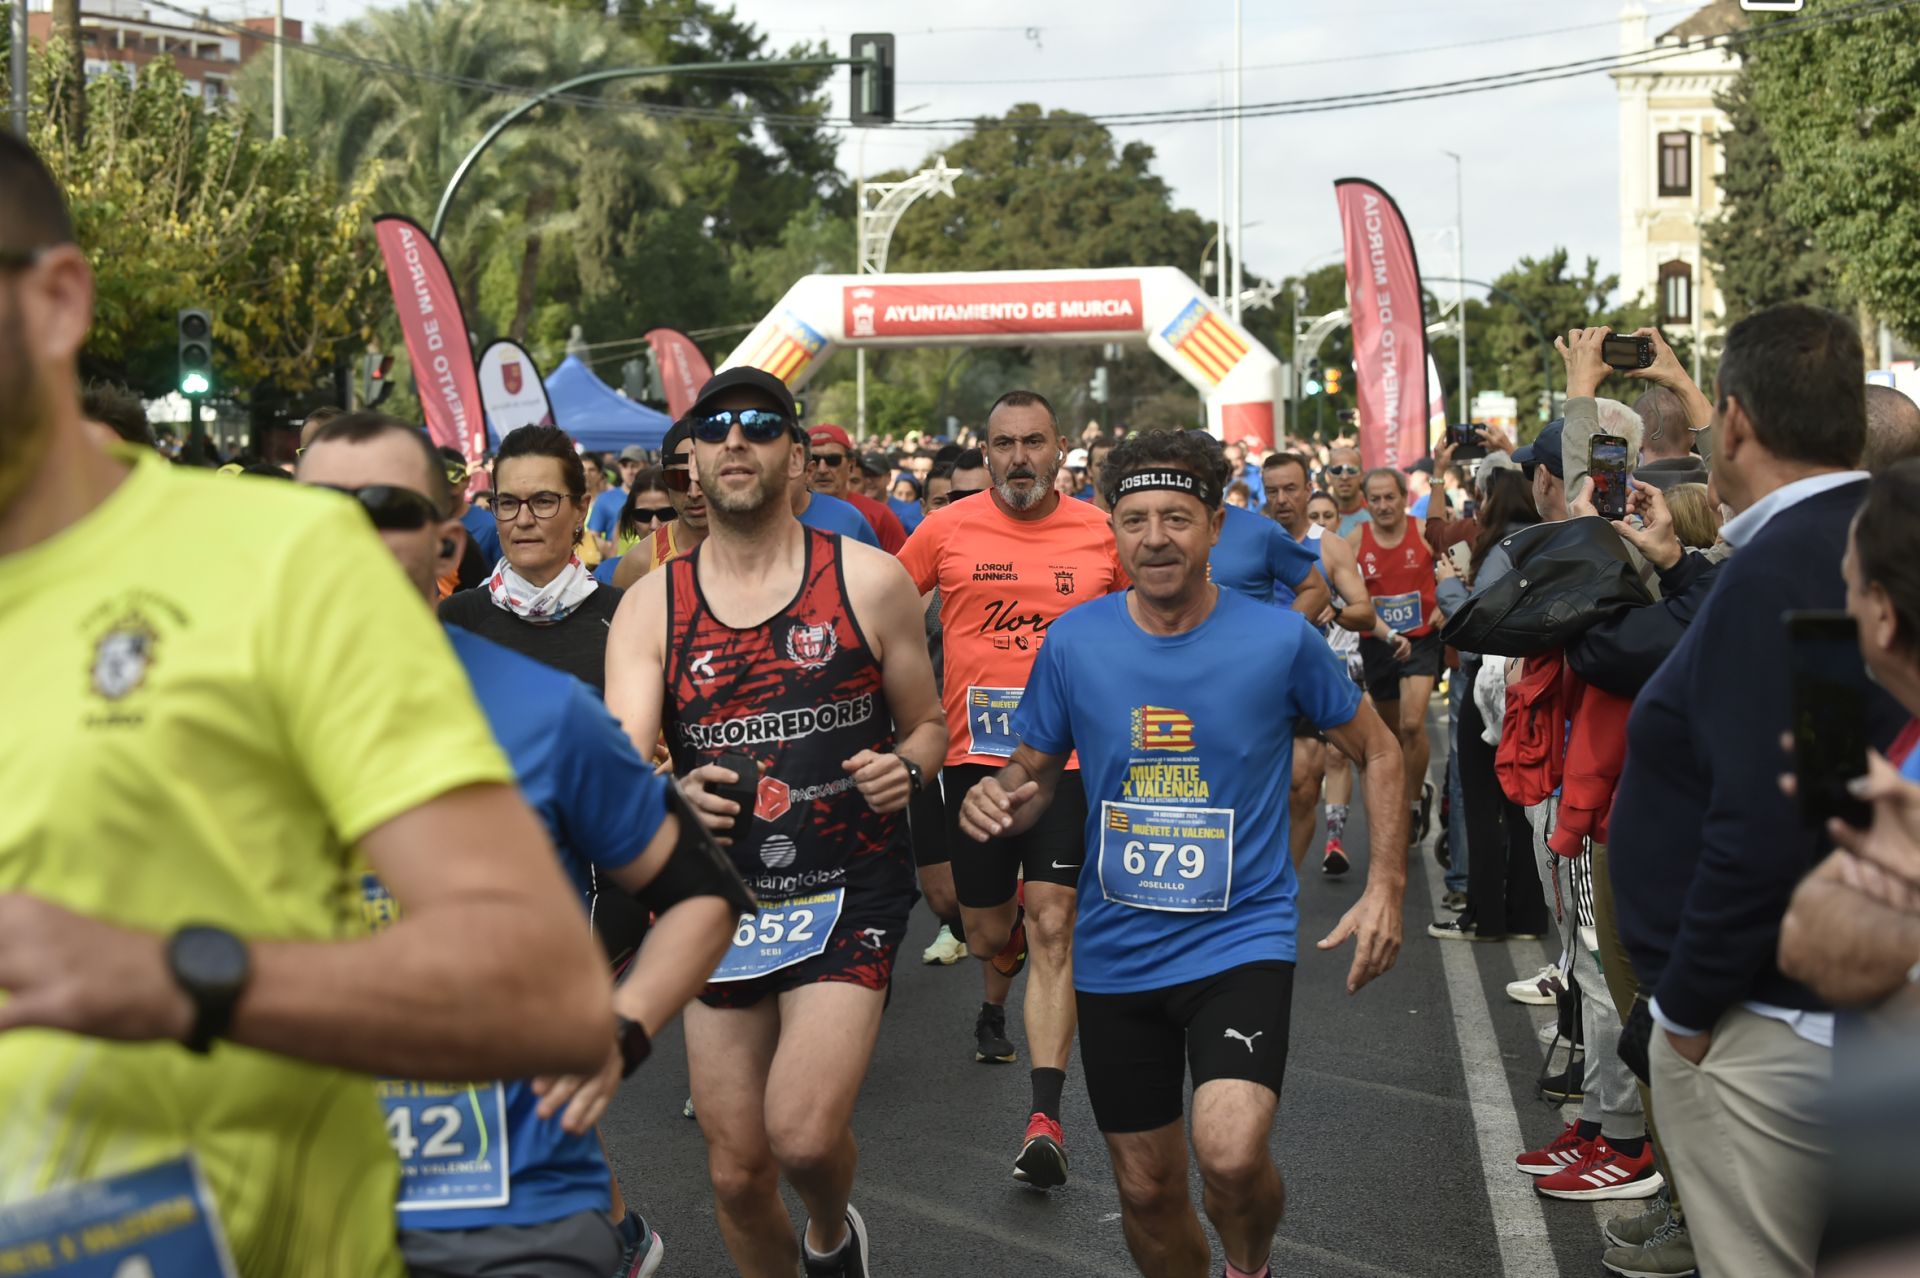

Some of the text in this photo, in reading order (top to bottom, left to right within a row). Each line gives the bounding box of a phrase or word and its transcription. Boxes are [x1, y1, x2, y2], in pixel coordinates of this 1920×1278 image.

[884, 299, 1133, 322] AYUNTAMIENTO DE MURCIA
[1119, 473, 1193, 492] JOSELILLO
[972, 573, 1018, 581] RUNNERS
[1384, 606, 1413, 622] 503
[978, 712, 1020, 736] 11
[1130, 762, 1200, 781] MUÉVETE
[790, 776, 857, 803] PACKAGIN
[1122, 780, 1209, 797] X VALENCIA
[1173, 827, 1179, 837] X
[1182, 827, 1225, 839] VALENCIA
[1123, 840, 1205, 878] 679
[1138, 880, 1185, 890] JOSELILLO
[733, 909, 814, 947] 652
[760, 948, 781, 956] SEBI
